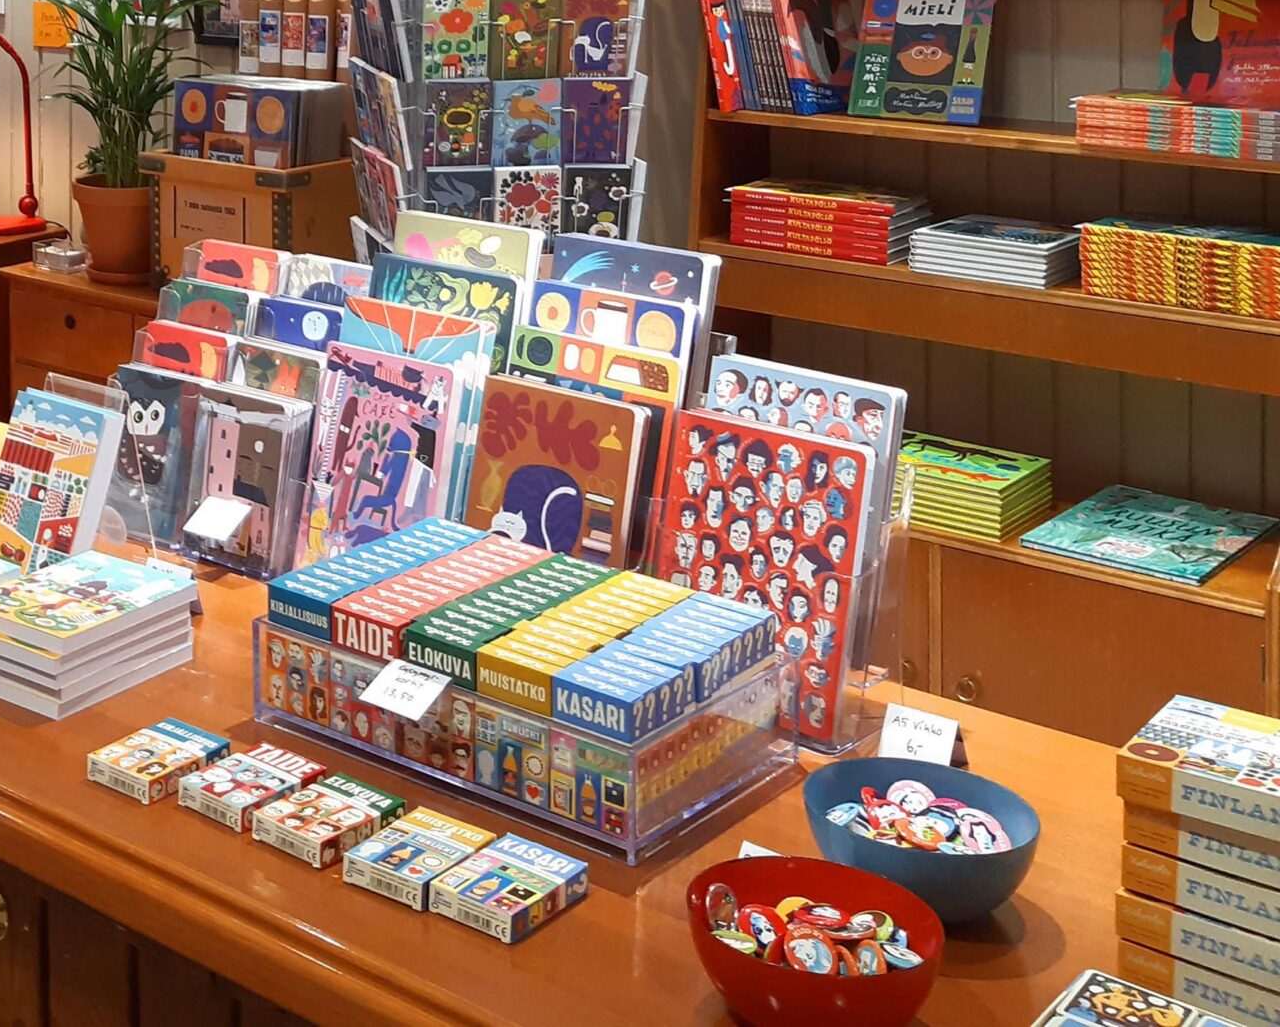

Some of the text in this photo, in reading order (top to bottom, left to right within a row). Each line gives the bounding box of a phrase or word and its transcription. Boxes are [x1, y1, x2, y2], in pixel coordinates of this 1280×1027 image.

[1094, 517, 1194, 543] MATKA
[1103, 506, 1223, 537] RUUSUN
[270, 600, 328, 629] KIRJALLISUUS
[334, 612, 394, 661] TAIDE
[408, 642, 471, 680] ELOKUVA
[479, 667, 546, 703] MUISTATKO
[556, 687, 626, 733] KASARI
[246, 742, 321, 778] TAIDE
[322, 775, 393, 809] ELOKUVA
[409, 811, 485, 843] MUISTATKO
[497, 836, 578, 875] KASARI
